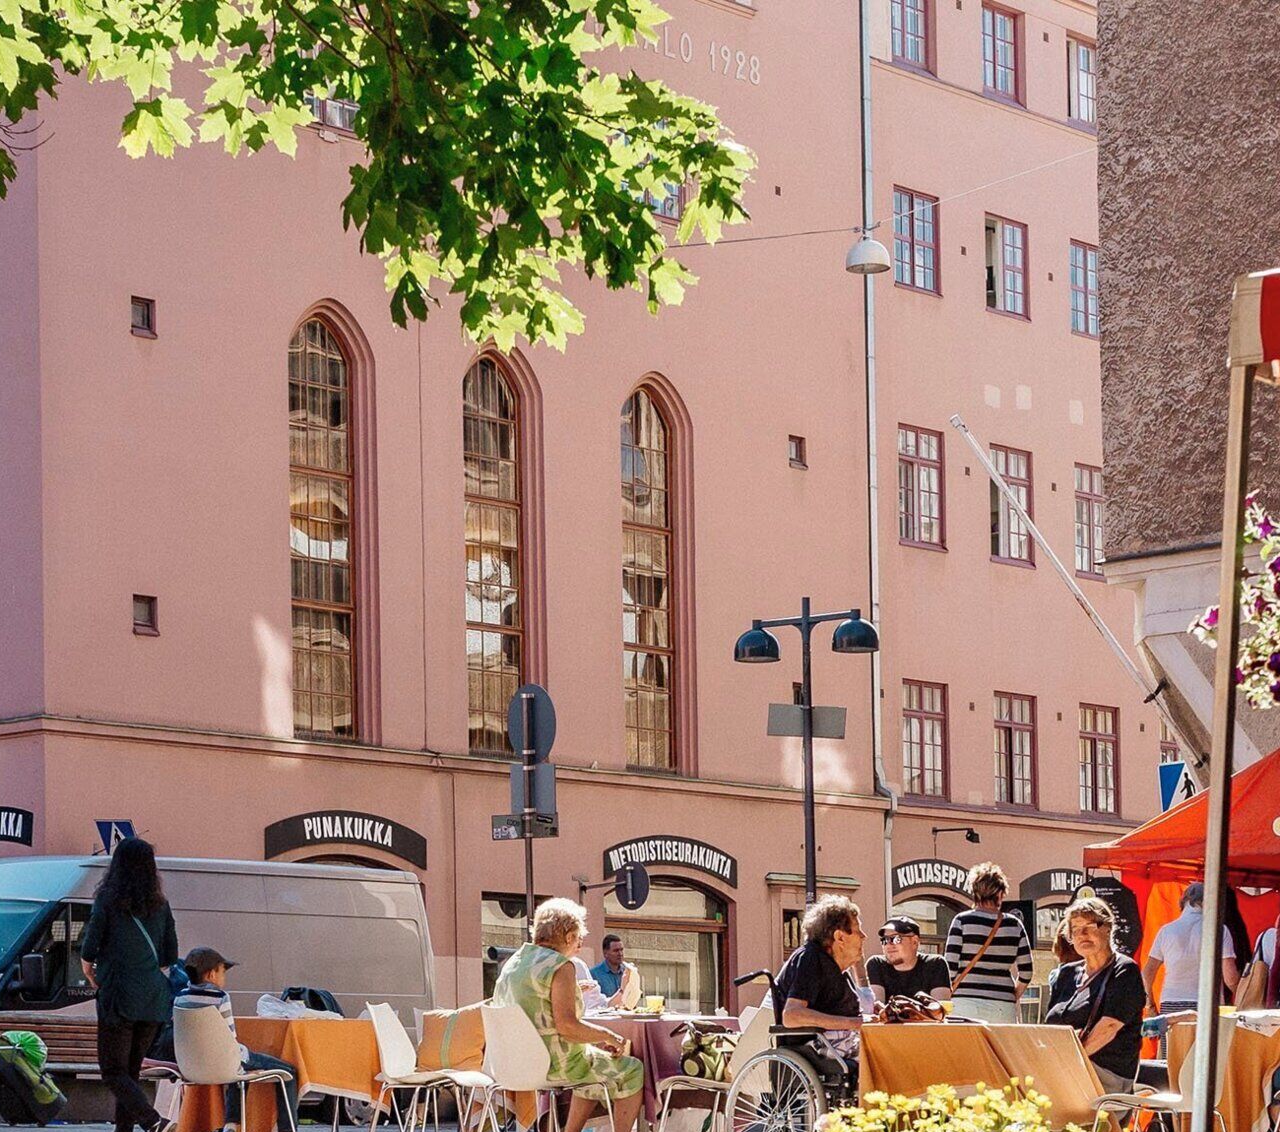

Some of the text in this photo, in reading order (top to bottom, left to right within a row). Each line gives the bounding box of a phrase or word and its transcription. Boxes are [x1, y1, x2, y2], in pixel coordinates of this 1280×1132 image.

[709, 41, 761, 86] 1928
[303, 816, 393, 848] PUNAKUKKA
[609, 840, 732, 879] METODISTISEURAKUNTA
